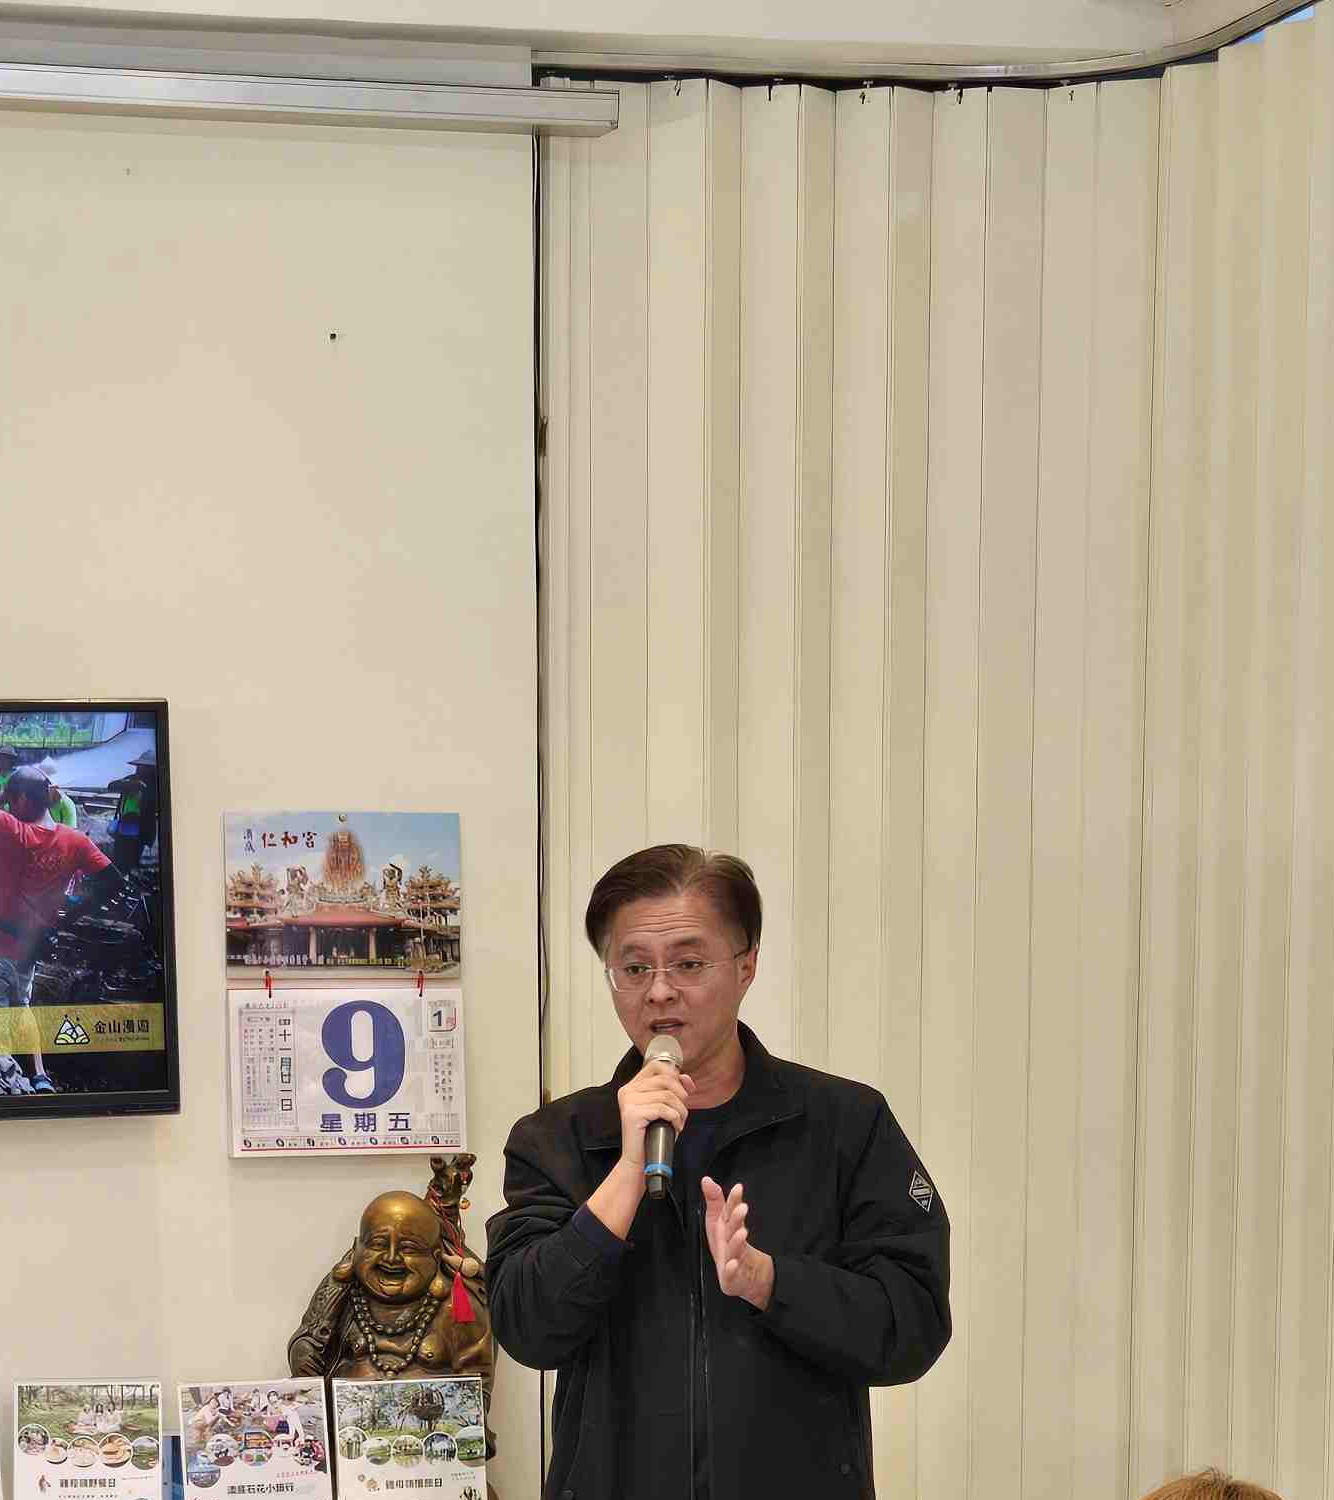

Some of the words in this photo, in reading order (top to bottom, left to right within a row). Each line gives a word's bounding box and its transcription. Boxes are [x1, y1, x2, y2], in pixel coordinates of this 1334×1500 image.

[321, 999, 407, 1110] 9
[320, 1112, 412, 1133] 星期五
